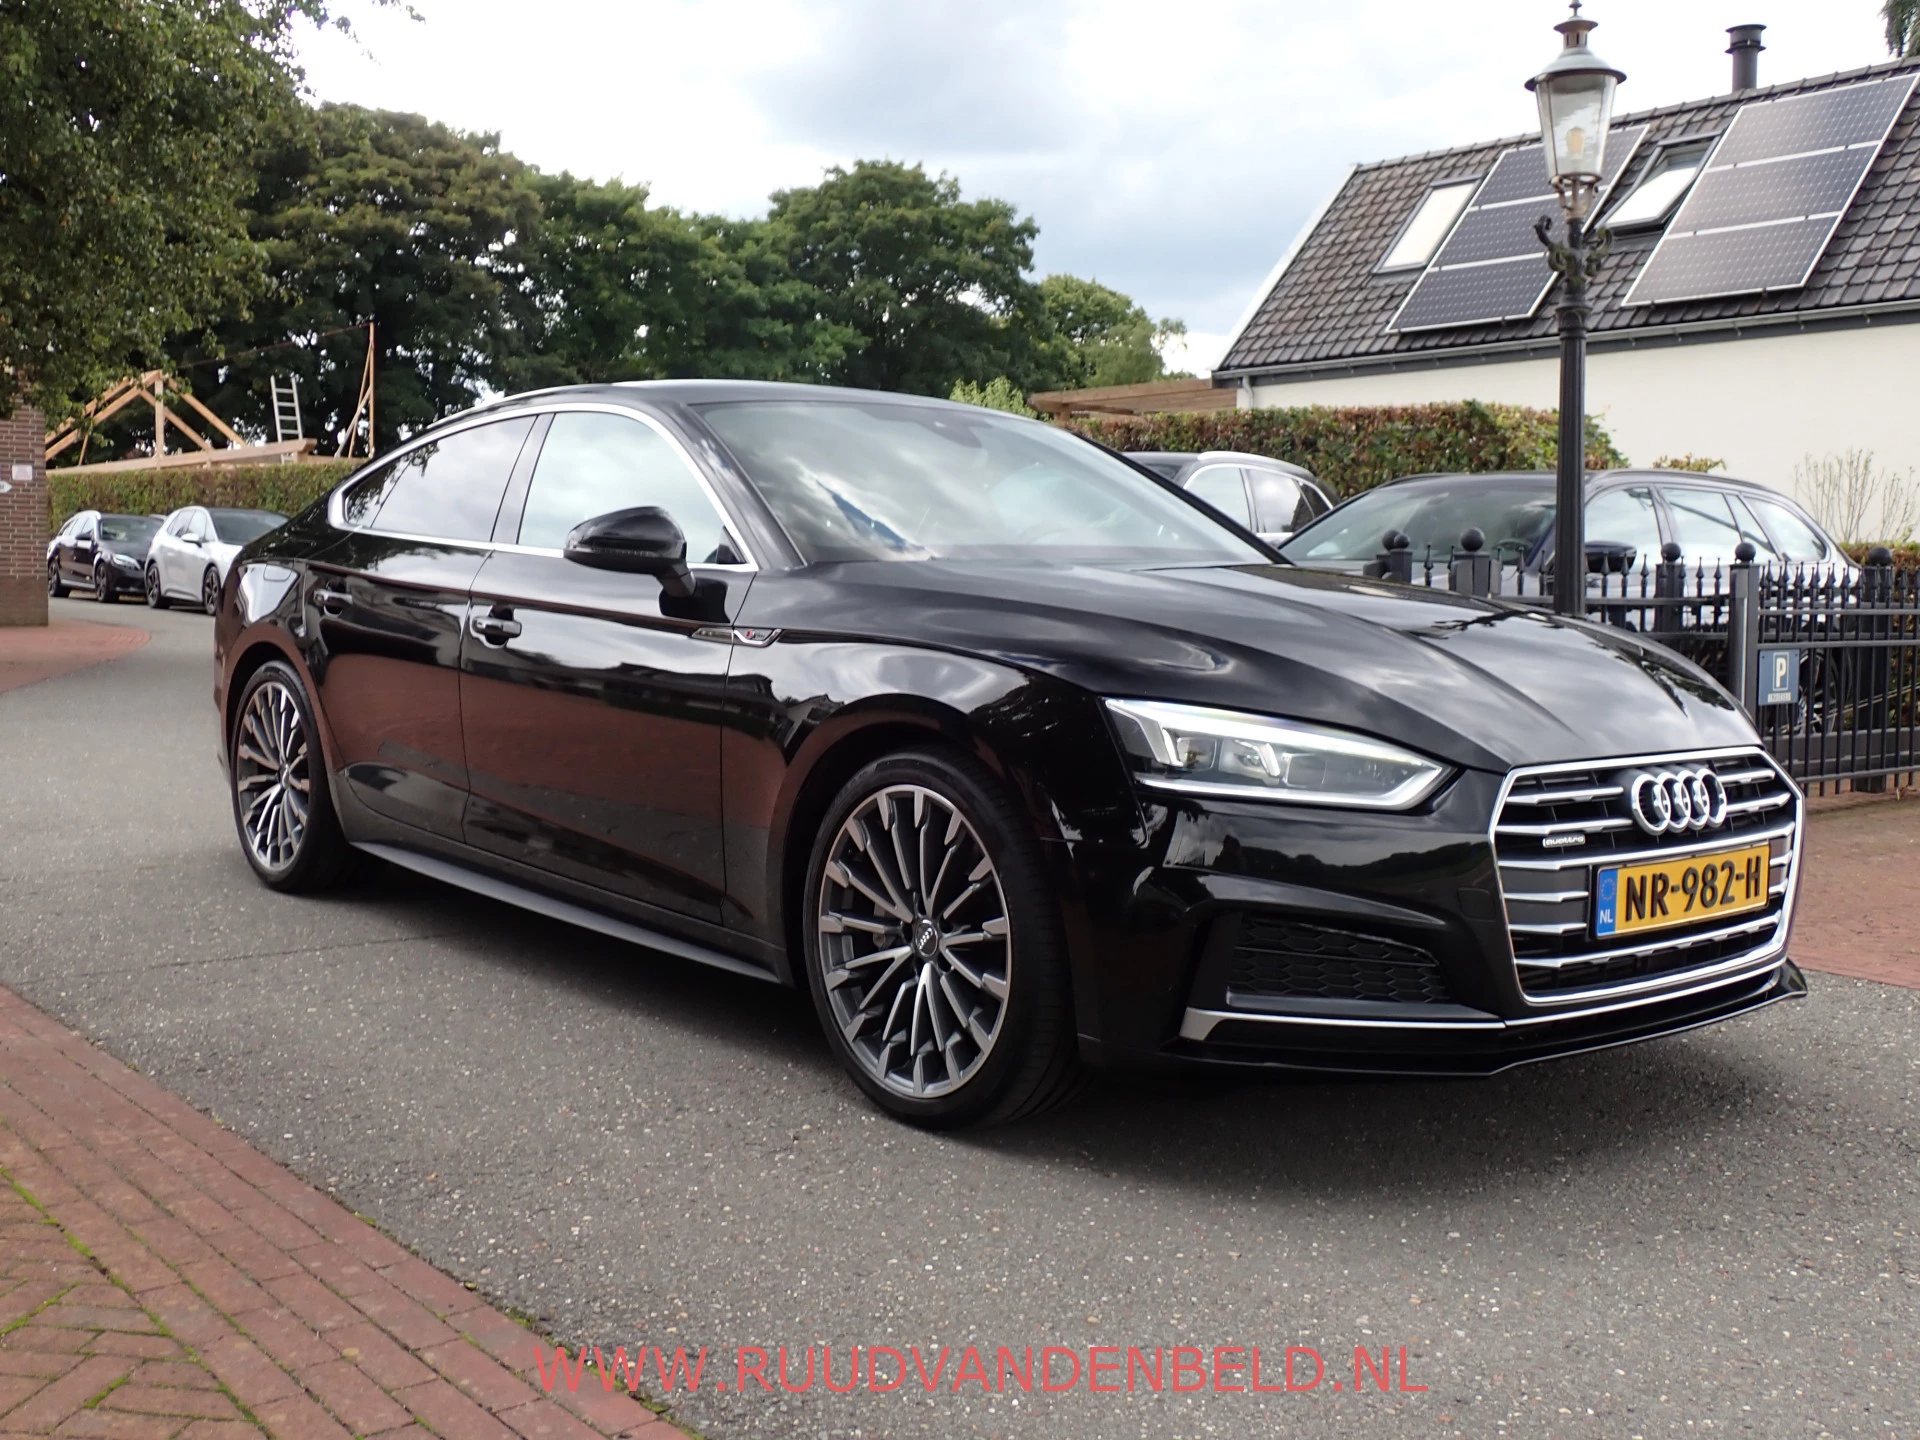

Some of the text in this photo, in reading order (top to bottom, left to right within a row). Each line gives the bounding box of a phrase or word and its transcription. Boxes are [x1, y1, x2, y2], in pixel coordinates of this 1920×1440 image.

[1775, 657, 1787, 688] P
[1625, 855, 1762, 922] NR-982-H
[1599, 909, 1614, 924] NL
